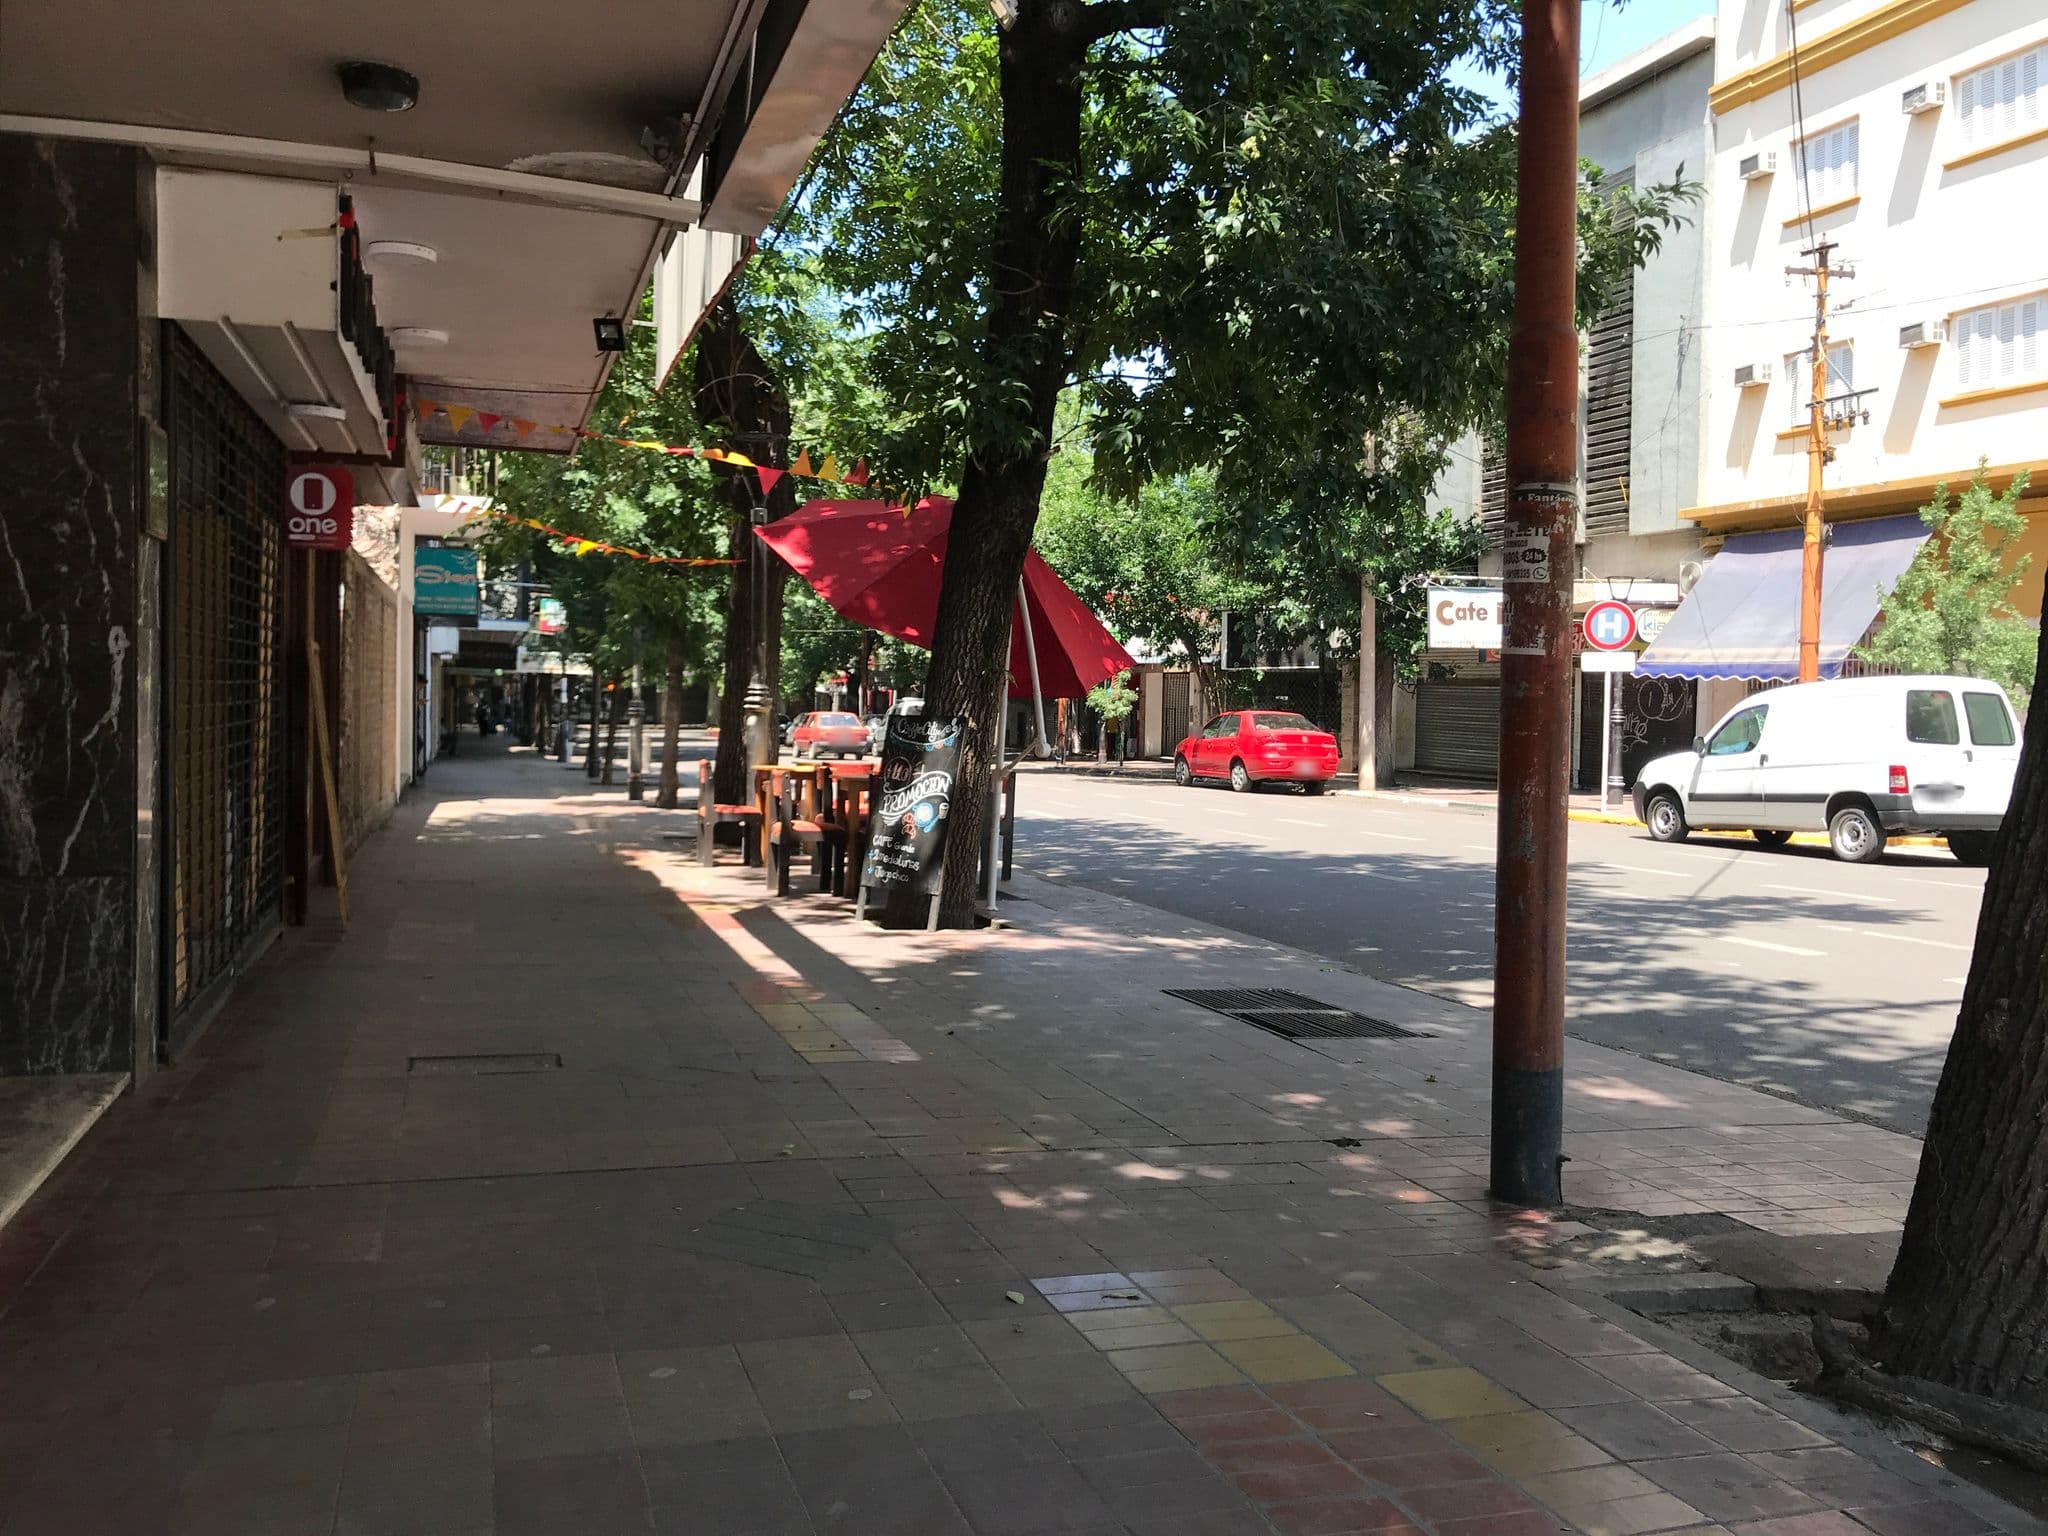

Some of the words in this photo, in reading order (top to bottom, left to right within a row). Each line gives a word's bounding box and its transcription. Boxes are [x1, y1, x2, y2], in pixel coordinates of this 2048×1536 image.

[288, 517, 338, 534] one
[1436, 599, 1489, 626] Cafe
[1597, 612, 1622, 639] H
